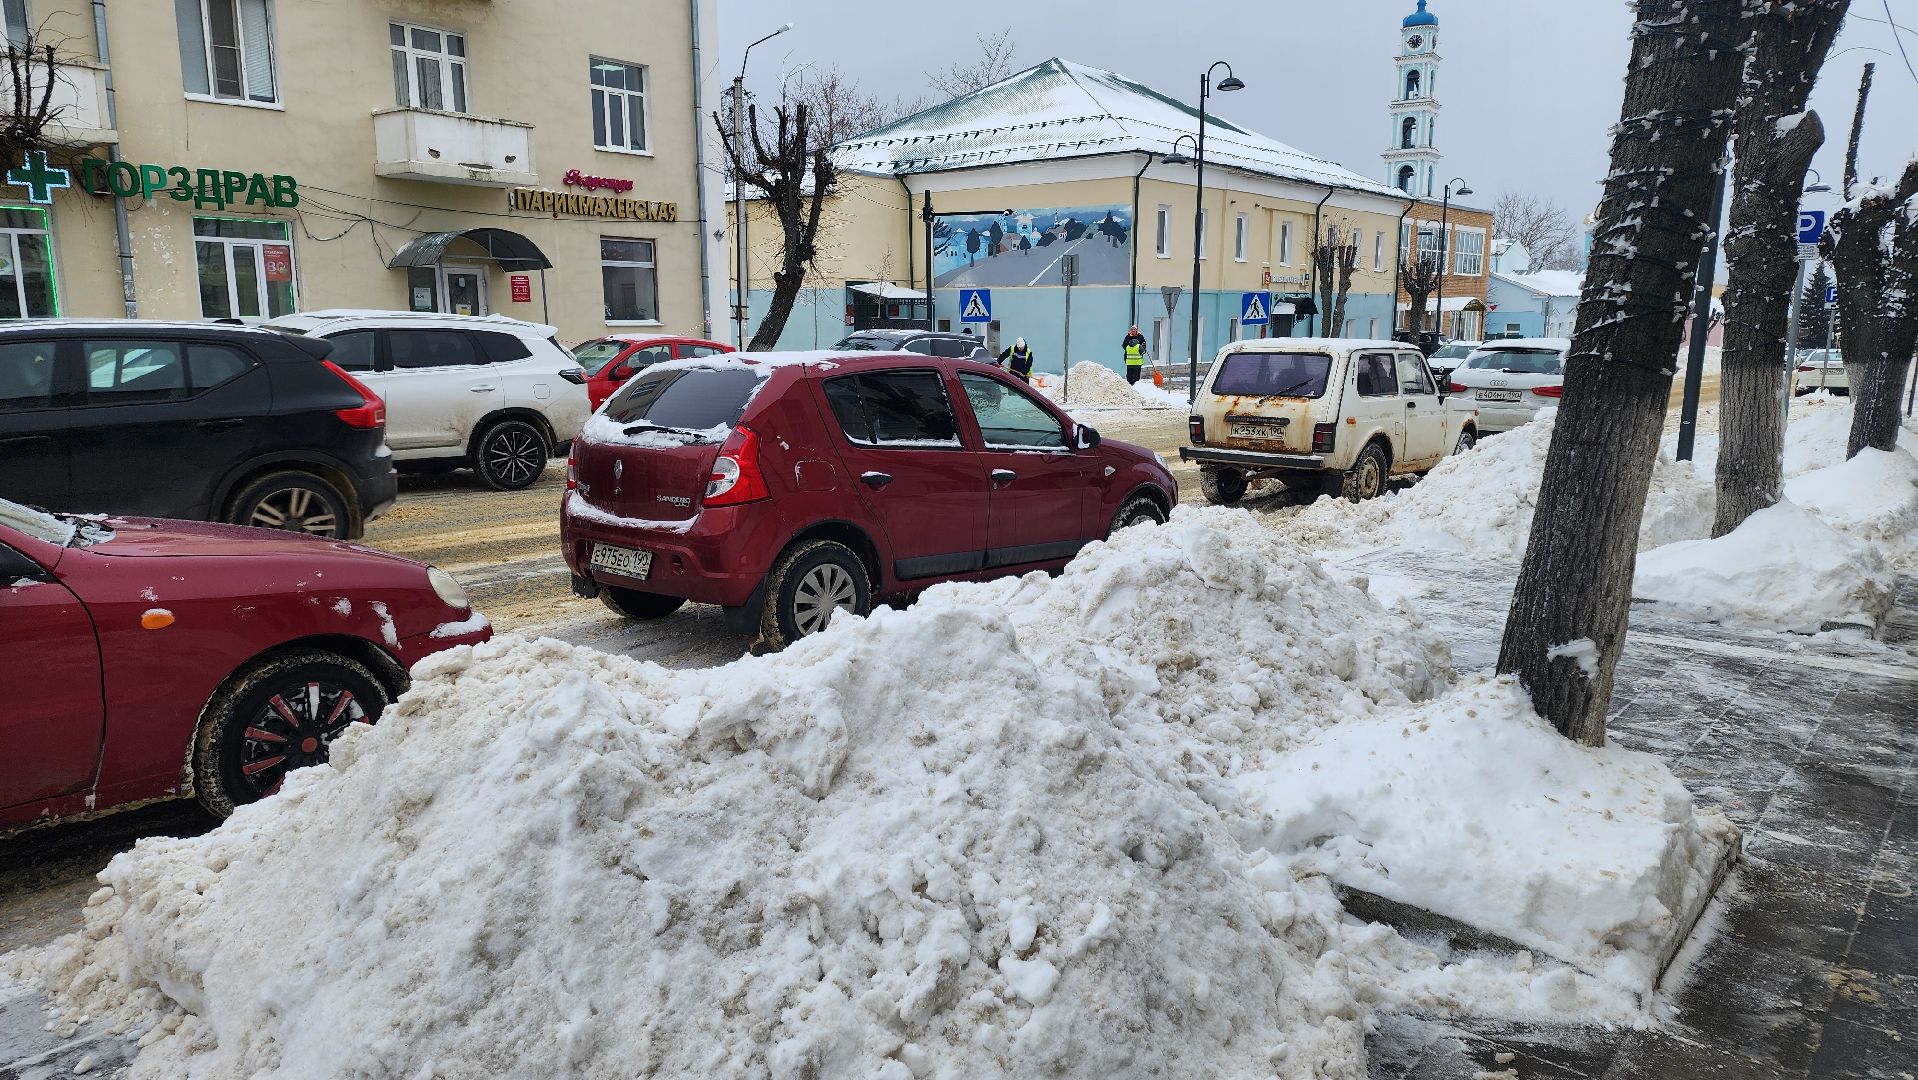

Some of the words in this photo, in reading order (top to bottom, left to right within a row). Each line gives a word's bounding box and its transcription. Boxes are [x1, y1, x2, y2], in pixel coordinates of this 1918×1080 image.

[83, 159, 300, 210] ГОРЗДРАВ
[516, 188, 677, 221] ПАРИКМАХЕРСКАЯ
[1796, 214, 1816, 236] P
[656, 494, 691, 503] SANDERO
[594, 546, 630, 568] Е975ЕО
[632, 552, 648, 567] 190
